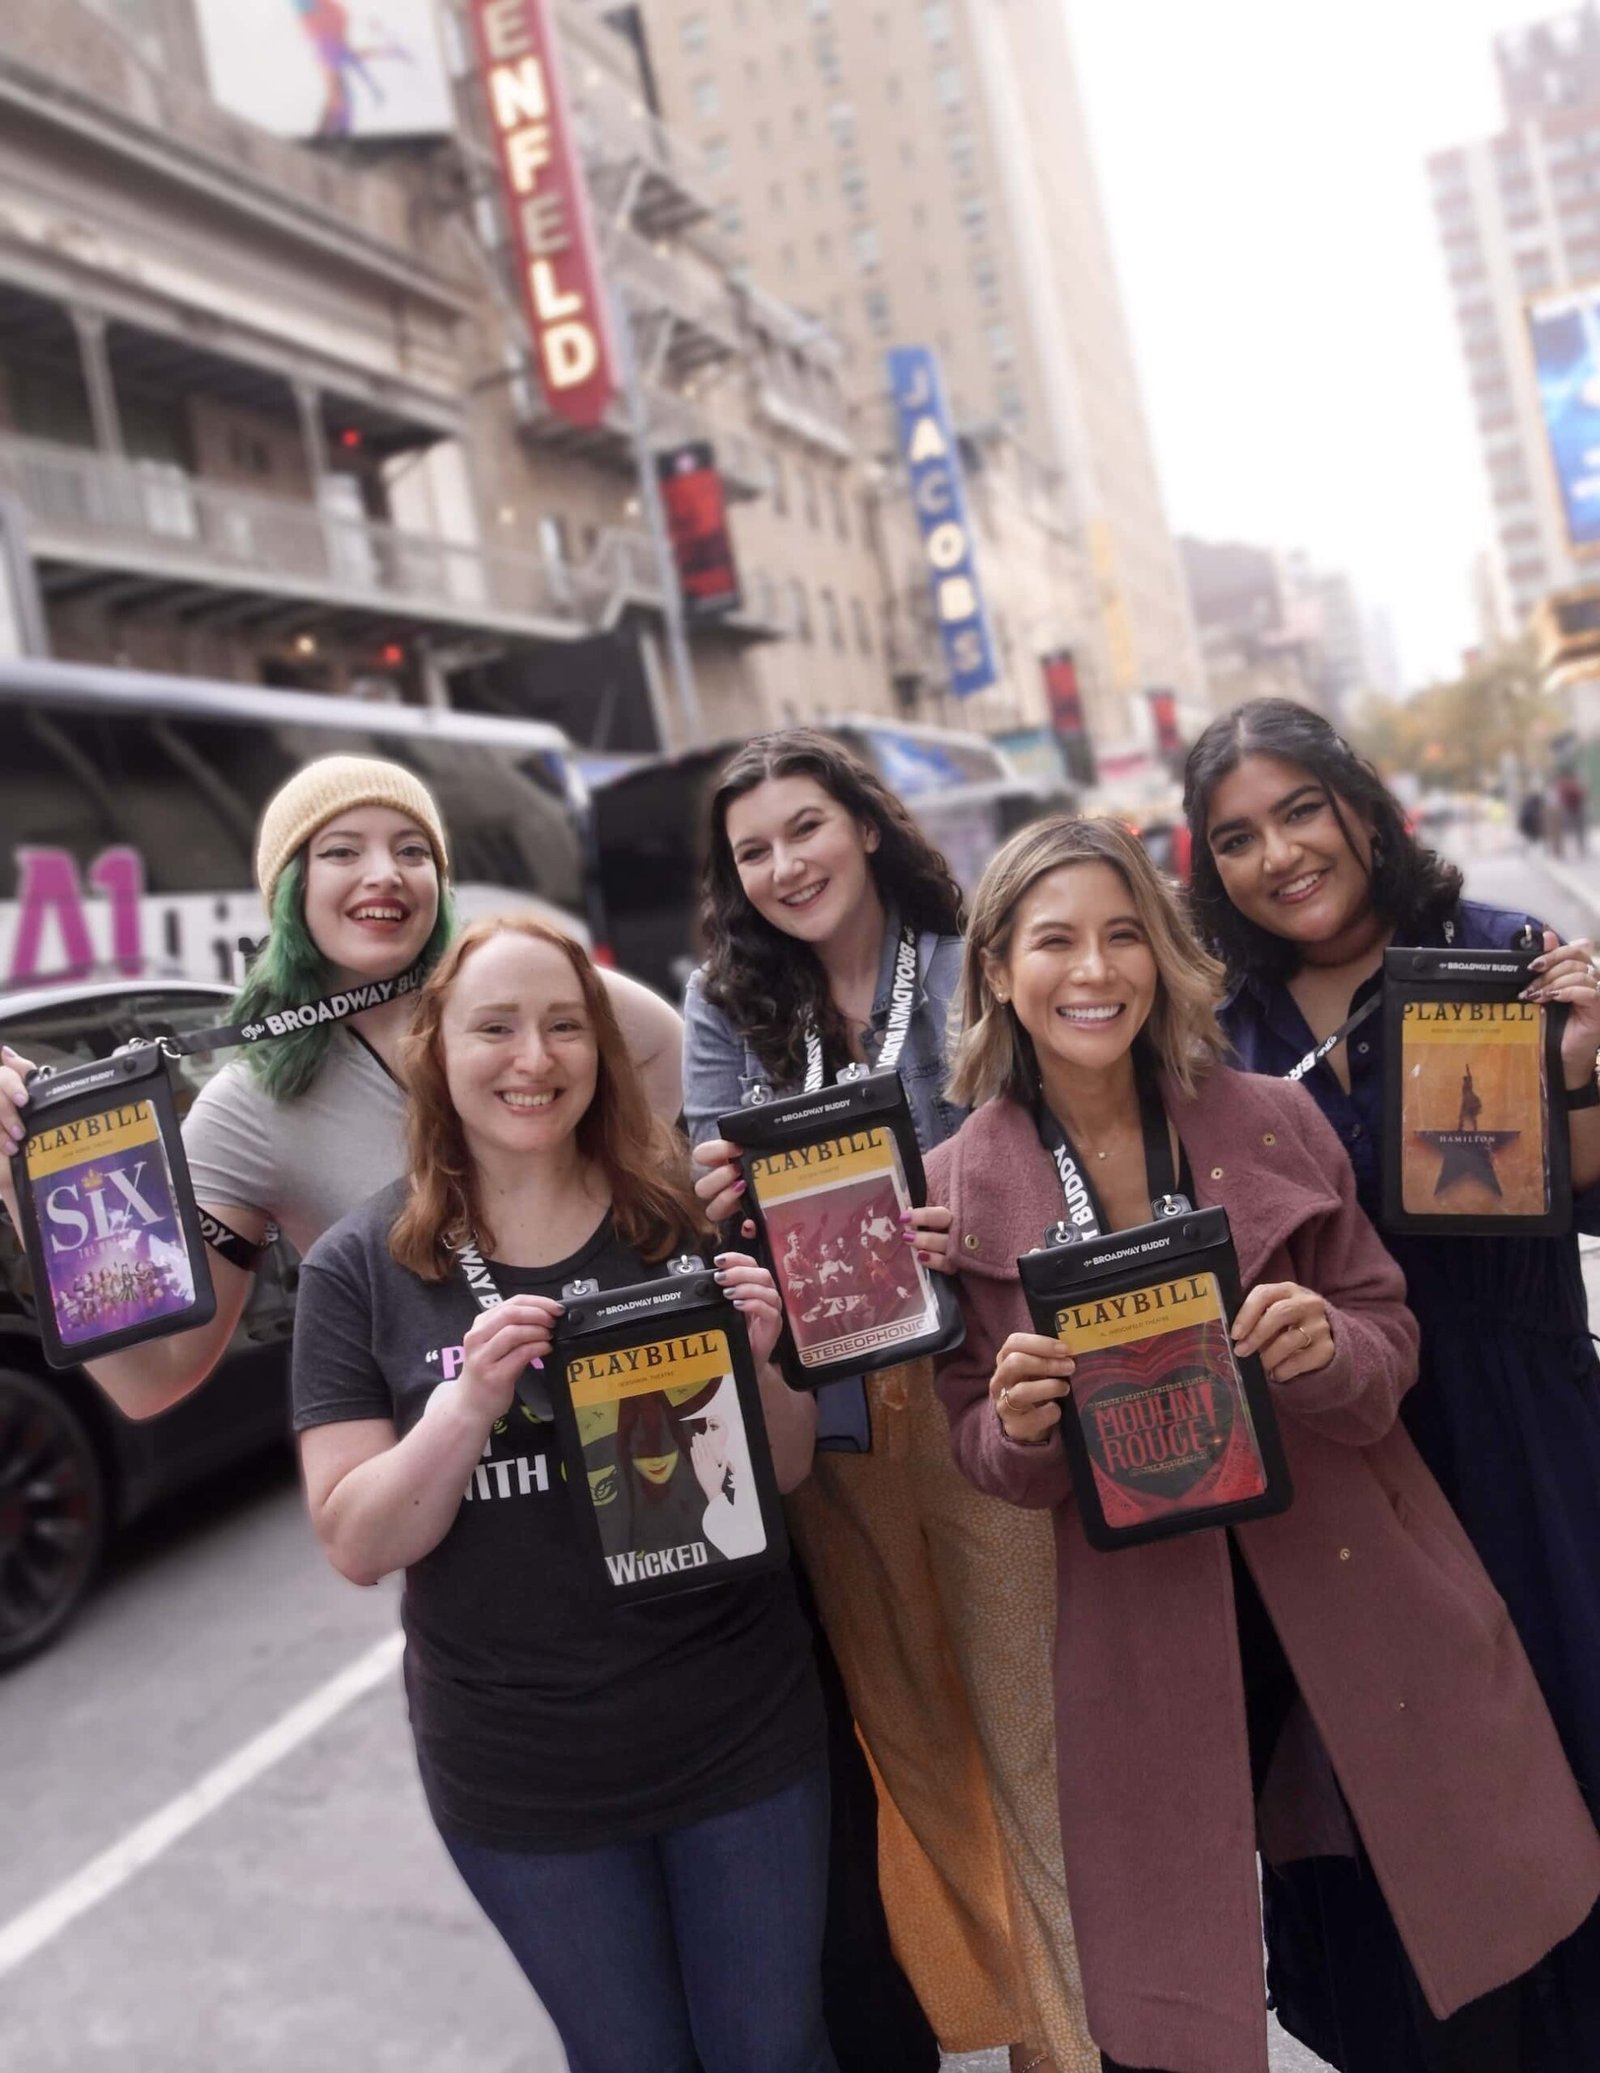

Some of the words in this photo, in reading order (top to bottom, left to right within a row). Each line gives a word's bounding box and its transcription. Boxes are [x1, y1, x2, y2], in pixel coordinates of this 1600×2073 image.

[902, 366, 983, 674] JACOBS
[887, 940, 917, 1029] BROADWAY
[241, 1022, 266, 1041] The
[265, 982, 393, 1036] BROADWAY
[1403, 1001, 1534, 1021] PLAYBILL
[26, 1102, 149, 1159] PLAYBILL
[782, 1105, 824, 1123] BROADWAY
[824, 1099, 851, 1112] BUDDY
[752, 1130, 883, 1180] PLAYBILL
[1439, 1135, 1496, 1143] HAMILTON
[46, 1160, 167, 1253] SIX
[1053, 1144, 1094, 1226] BUDDY
[1092, 1245, 1141, 1266] BROADWAY
[1140, 1237, 1171, 1252] BUDDY
[605, 1297, 653, 1315] BROADWAY
[652, 1291, 683, 1304] BUDDY
[1056, 1277, 1208, 1333] PLAYBILL
[567, 1332, 719, 1384] PLAYBILL
[801, 1320, 927, 1362] STEREOPHONIC
